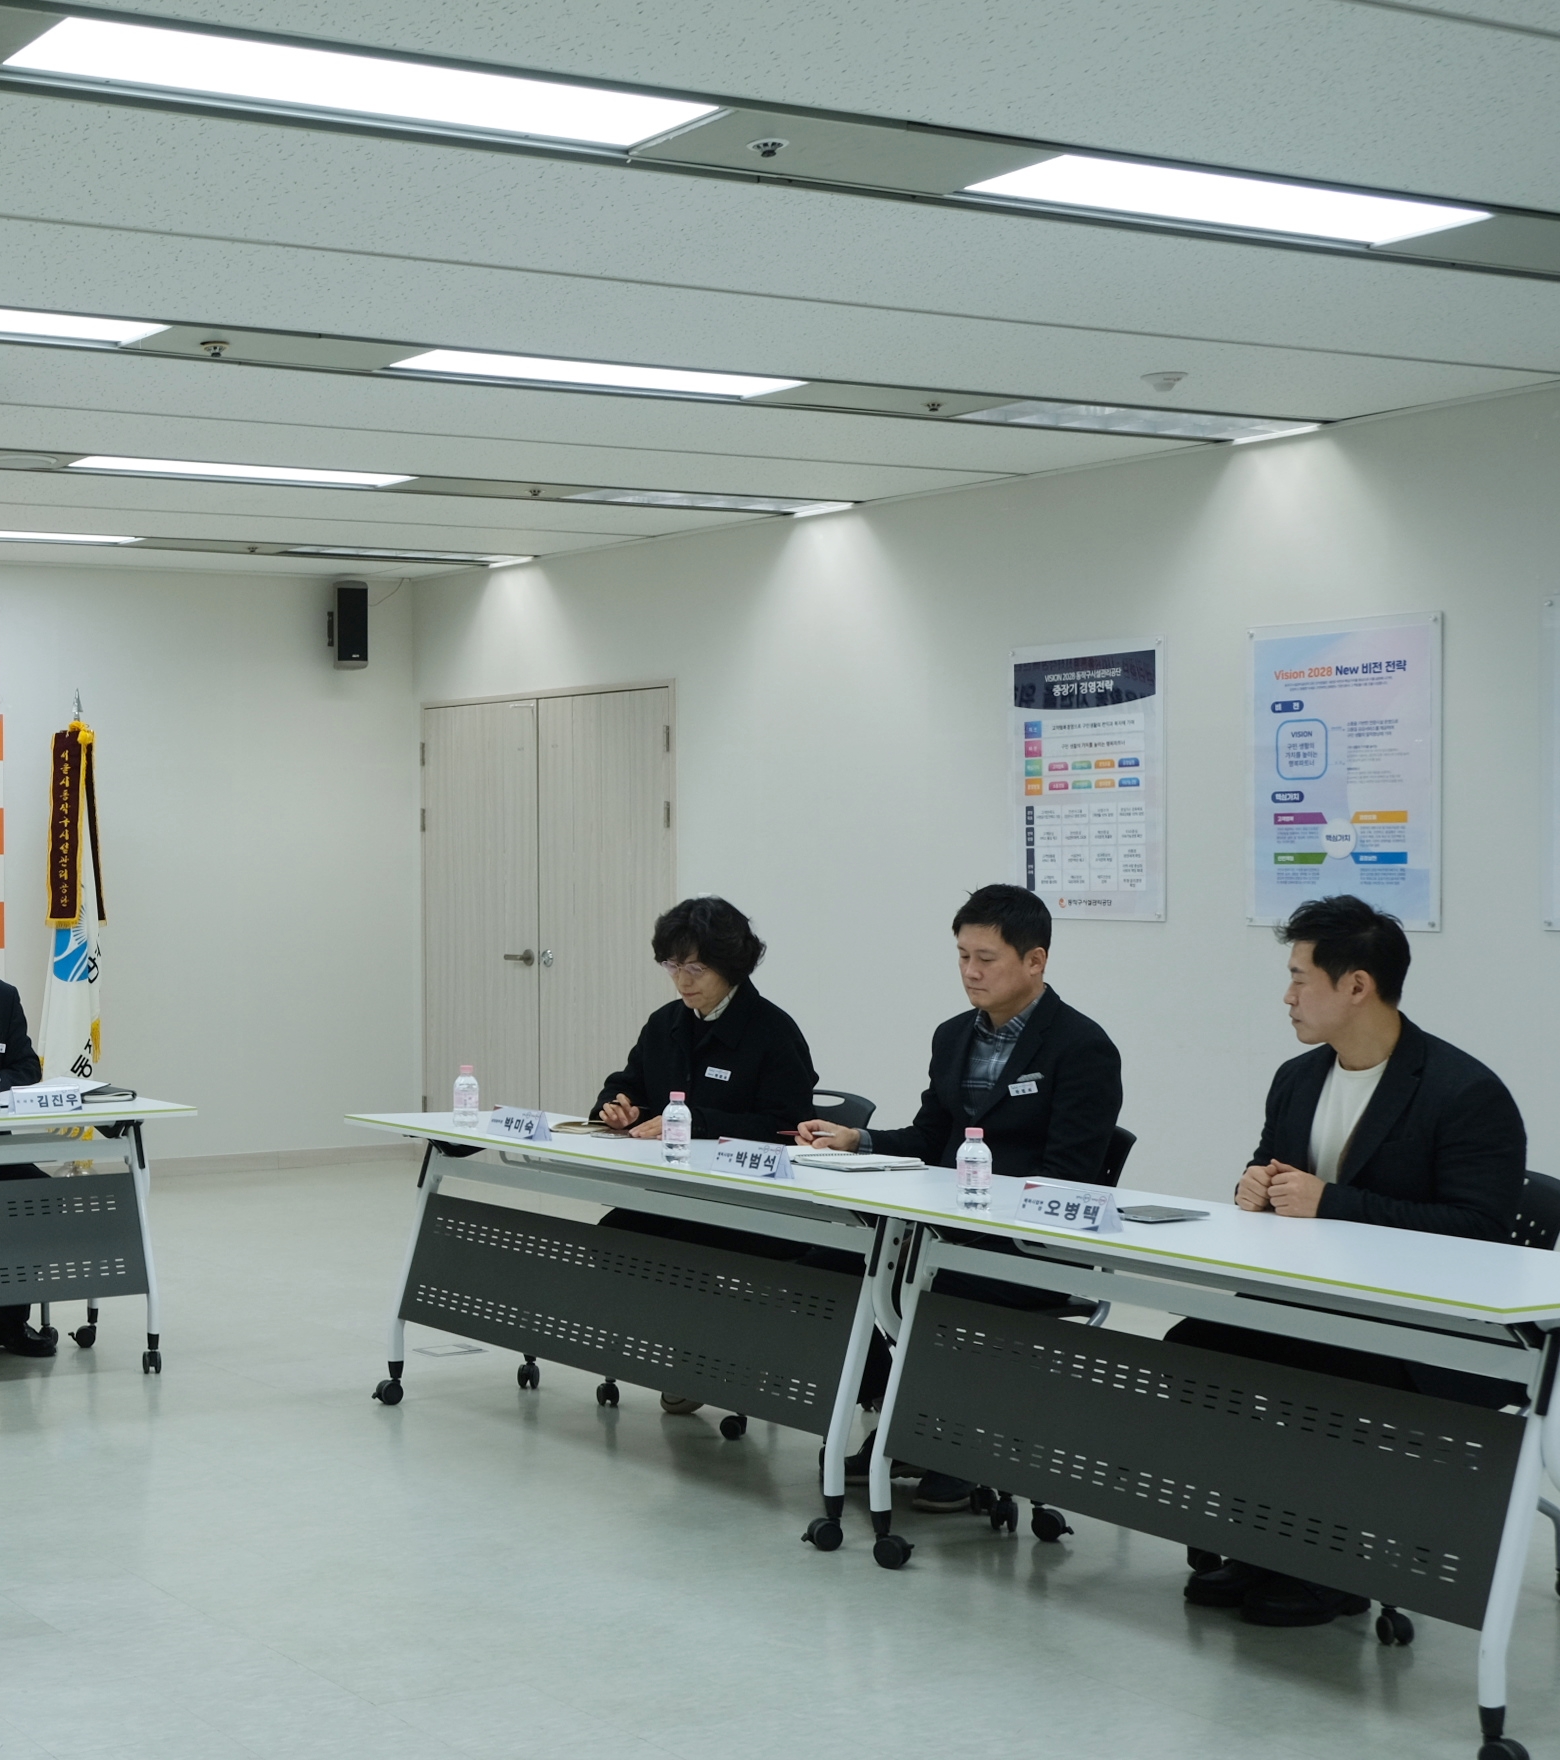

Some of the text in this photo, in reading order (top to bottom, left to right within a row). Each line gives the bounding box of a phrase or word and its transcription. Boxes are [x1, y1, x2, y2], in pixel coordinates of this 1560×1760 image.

[1274, 659, 1407, 681] Vision 2028 New 비전 전략
[1052, 679, 1114, 697] 중장기 경영전략
[1290, 730, 1313, 738] VISION
[1325, 834, 1351, 842] 핵심가치
[37, 1093, 79, 1109] 김진우
[504, 1117, 534, 1135] 박미숙
[735, 1151, 777, 1172] 박범석
[1044, 1199, 1100, 1225] 오병택
